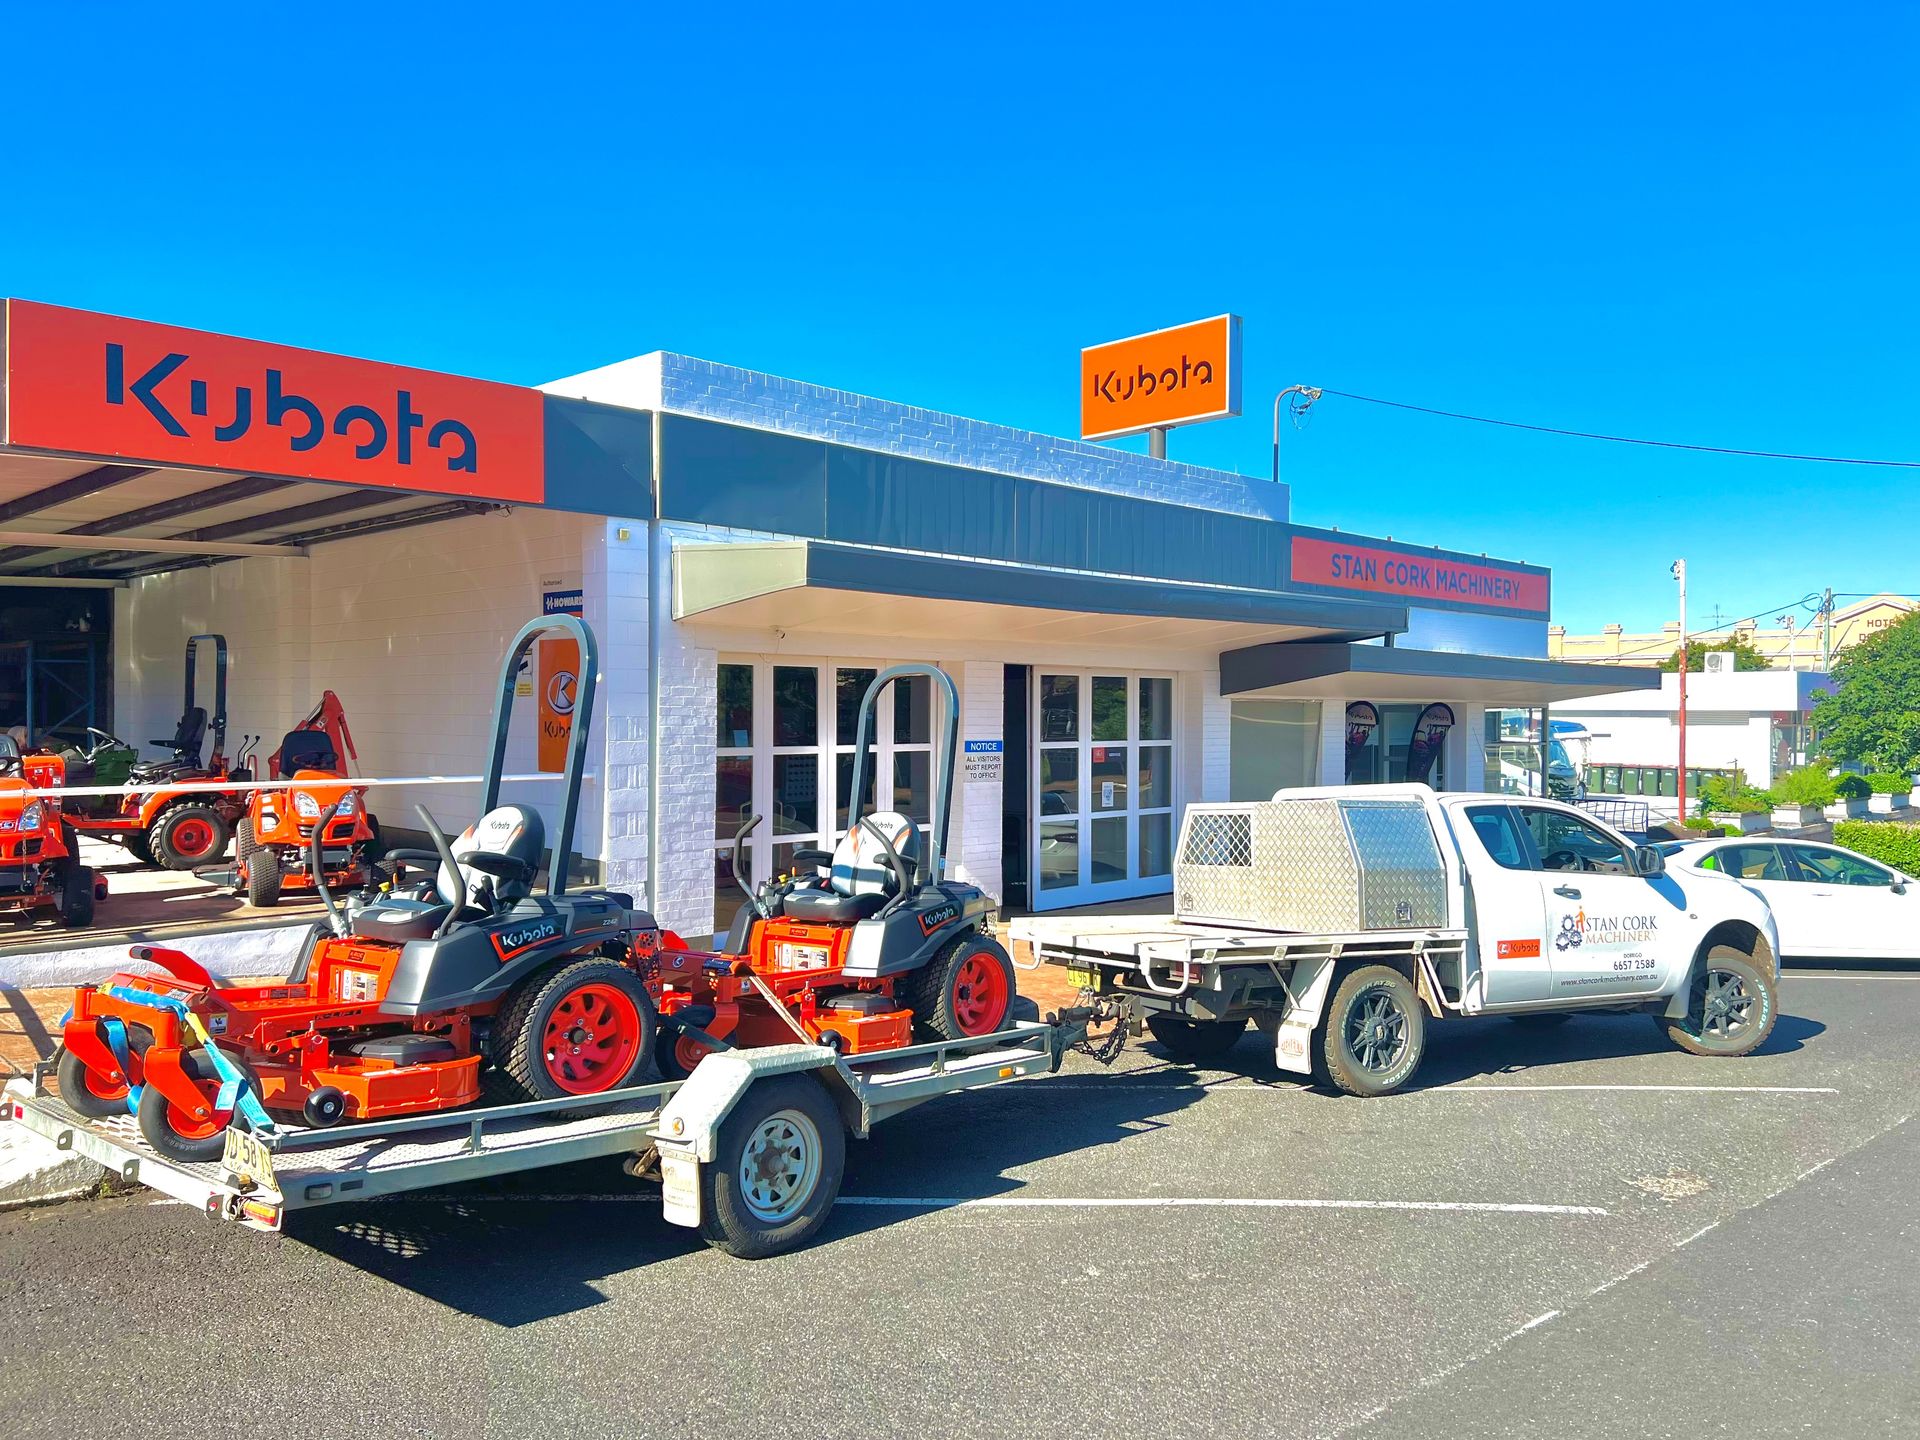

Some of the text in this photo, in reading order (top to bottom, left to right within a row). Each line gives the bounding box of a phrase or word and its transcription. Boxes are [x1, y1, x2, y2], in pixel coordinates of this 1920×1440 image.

[1094, 354, 1213, 403] Kubota
[105, 342, 477, 474] Kubota
[1331, 553, 1520, 601] STAN CORK MACHINERY
[1867, 619, 1897, 628] HOTE
[970, 742, 998, 751] NOTICE
[490, 820, 511, 830] Kubota
[924, 906, 954, 926] Kubota
[1586, 915, 1658, 932] STAN CORK
[502, 923, 555, 947] Kubota
[1585, 931, 1657, 944] MACHINERY
[1510, 943, 1539, 953] Kubota
[1613, 959, 1656, 971] 6657 2588
[1560, 973, 1658, 987] www.stancorkmachinery.com.au
[1758, 984, 1768, 1029] DUNLOP
[1382, 1051, 1416, 1085] DUNLOP
